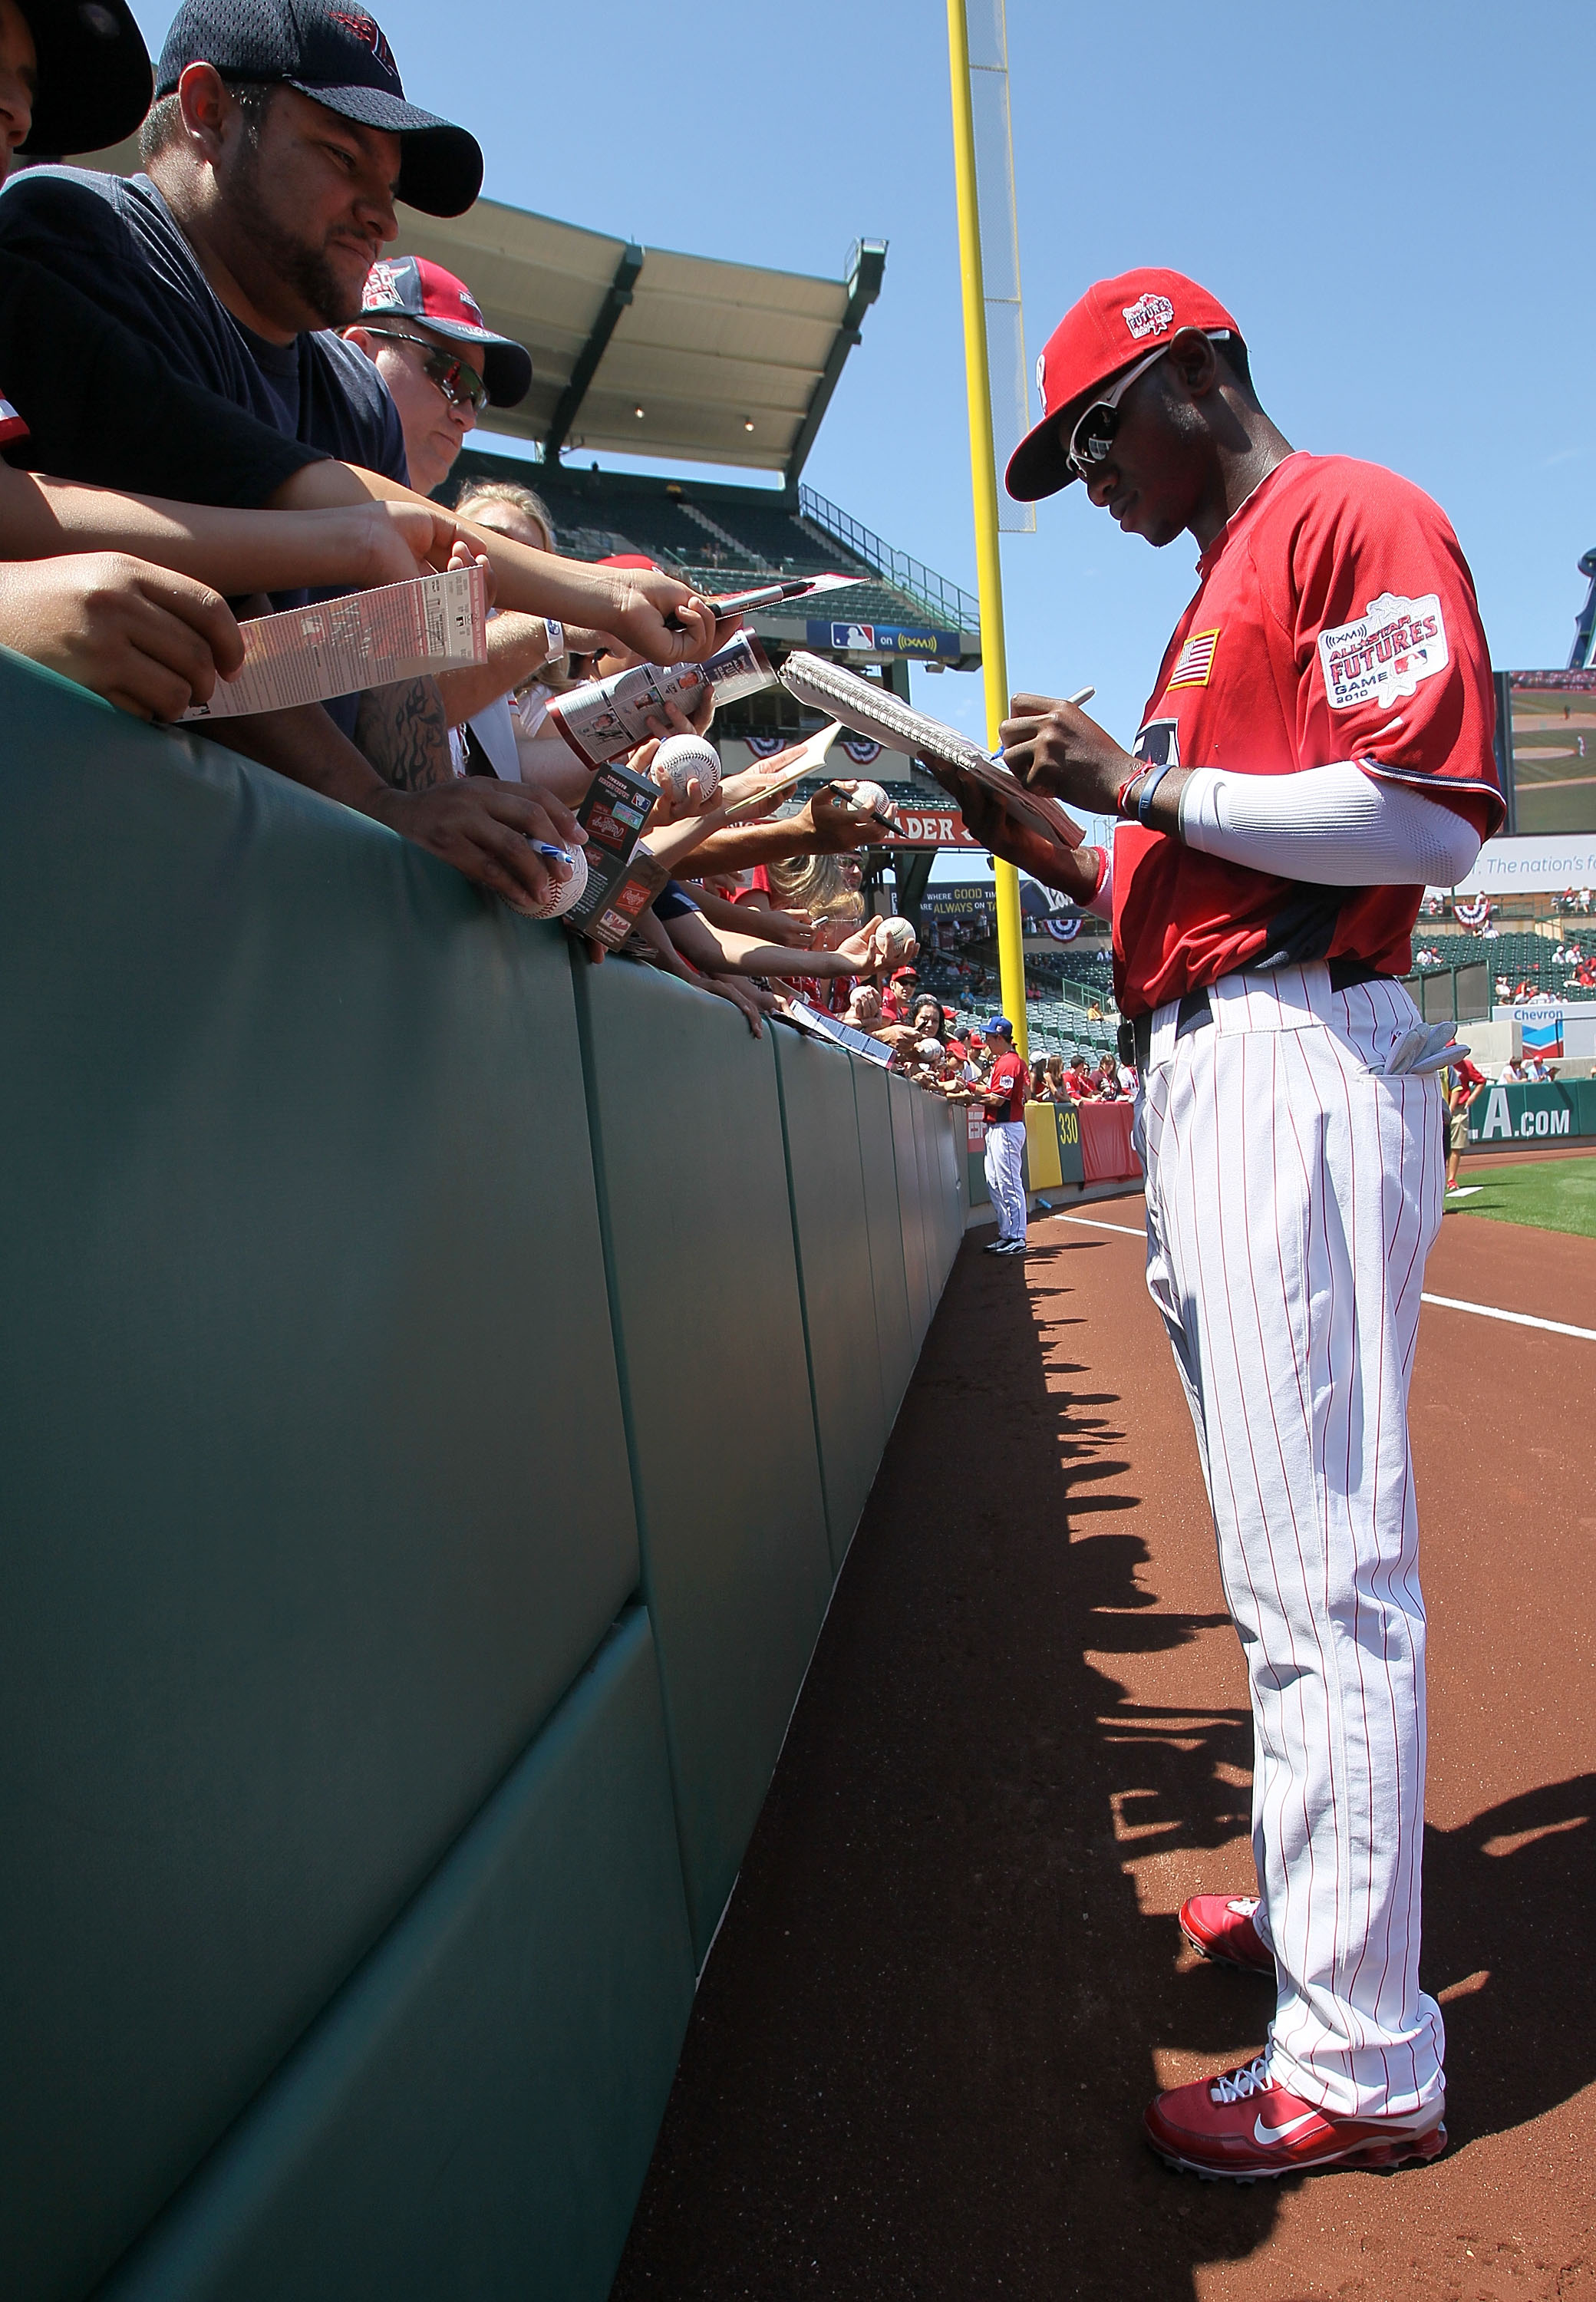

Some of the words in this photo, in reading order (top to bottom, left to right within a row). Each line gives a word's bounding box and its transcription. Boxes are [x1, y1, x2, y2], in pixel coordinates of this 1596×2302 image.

[1129, 299, 1170, 328] FUTURES
[880, 636, 893, 646] on
[1330, 615, 1439, 687] FUTURES
[1334, 671, 1389, 695] GAME
[1337, 689, 1368, 704] 2010
[592, 816, 625, 838] Rawlings
[884, 817, 956, 839] ADER
[1487, 858, 1517, 874] The
[1520, 856, 1584, 872] nation's
[927, 892, 951, 901] WHERE
[954, 887, 982, 899] GOOD
[934, 902, 974, 914] ALWAYS
[1514, 1009, 1564, 1021] Chevron
[1058, 1113, 1078, 1145] 330
